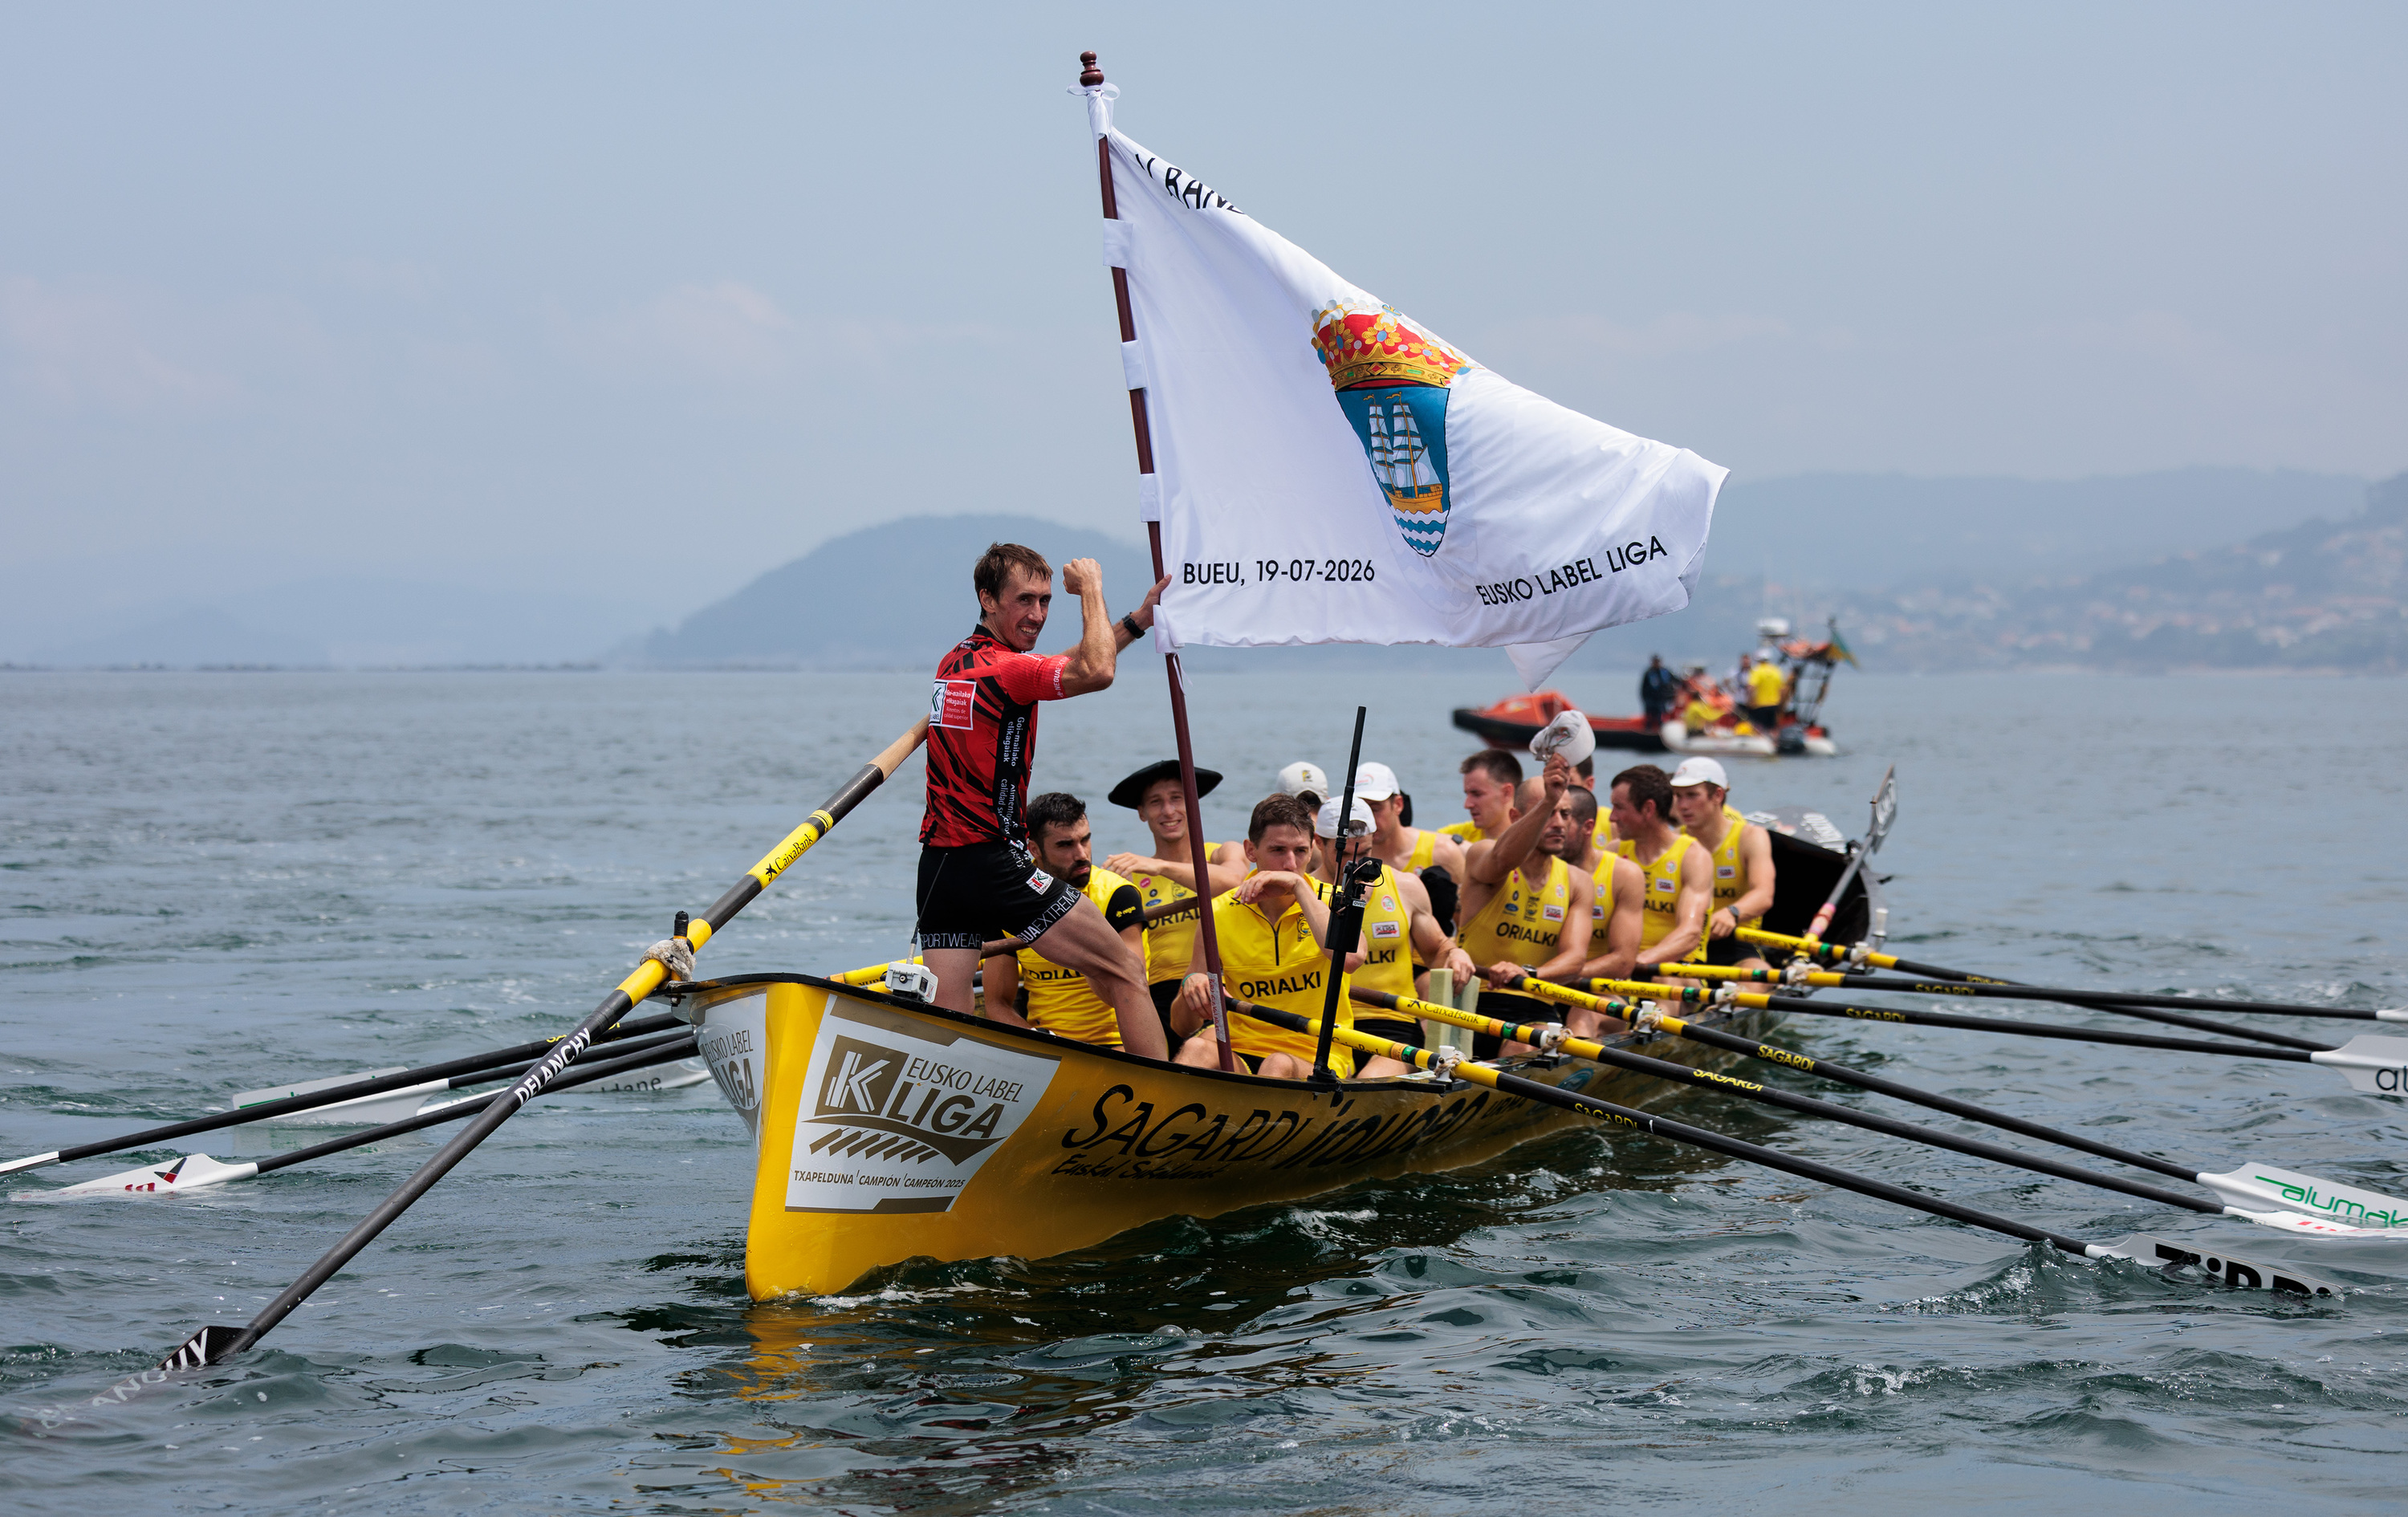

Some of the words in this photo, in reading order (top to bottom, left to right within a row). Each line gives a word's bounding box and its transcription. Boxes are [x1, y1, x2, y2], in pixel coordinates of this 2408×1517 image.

[1183, 562, 1245, 586] BUEU,
[1256, 559, 1375, 582] 19-07-2026
[1475, 578, 1533, 606] EUSKO
[1535, 558, 1603, 596] LABEL
[1606, 535, 1668, 573] LIGA
[1003, 721, 1015, 763] elikagaiak
[1011, 717, 1025, 767] Goi-mailako
[998, 779, 1008, 807] calidad
[775, 833, 814, 871] CaixaBank
[1495, 921, 1559, 947] ORIALKI
[1239, 970, 1321, 998] ORIALKI
[1543, 985, 1588, 1006] CaixaBank
[1423, 1003, 1480, 1025] CaixaBank
[705, 1036, 728, 1064] EUSKO
[726, 1029, 754, 1056] LABEL
[1757, 1044, 1816, 1072] SAGARDI
[714, 1057, 756, 1108] LIGA
[907, 1057, 972, 1091] EUSKO
[972, 1075, 1024, 1103] LABEL
[886, 1080, 1006, 1139] LIGA
[1061, 1084, 1314, 1162] SAGARDI
[794, 1170, 853, 1185] TXAPELDUNA
[859, 1173, 901, 1187] CAMPIÓN
[904, 1177, 946, 1188] CAMPEÓN
[945, 1179, 966, 1188] 2025
[1051, 1153, 1132, 1177] Euskal
